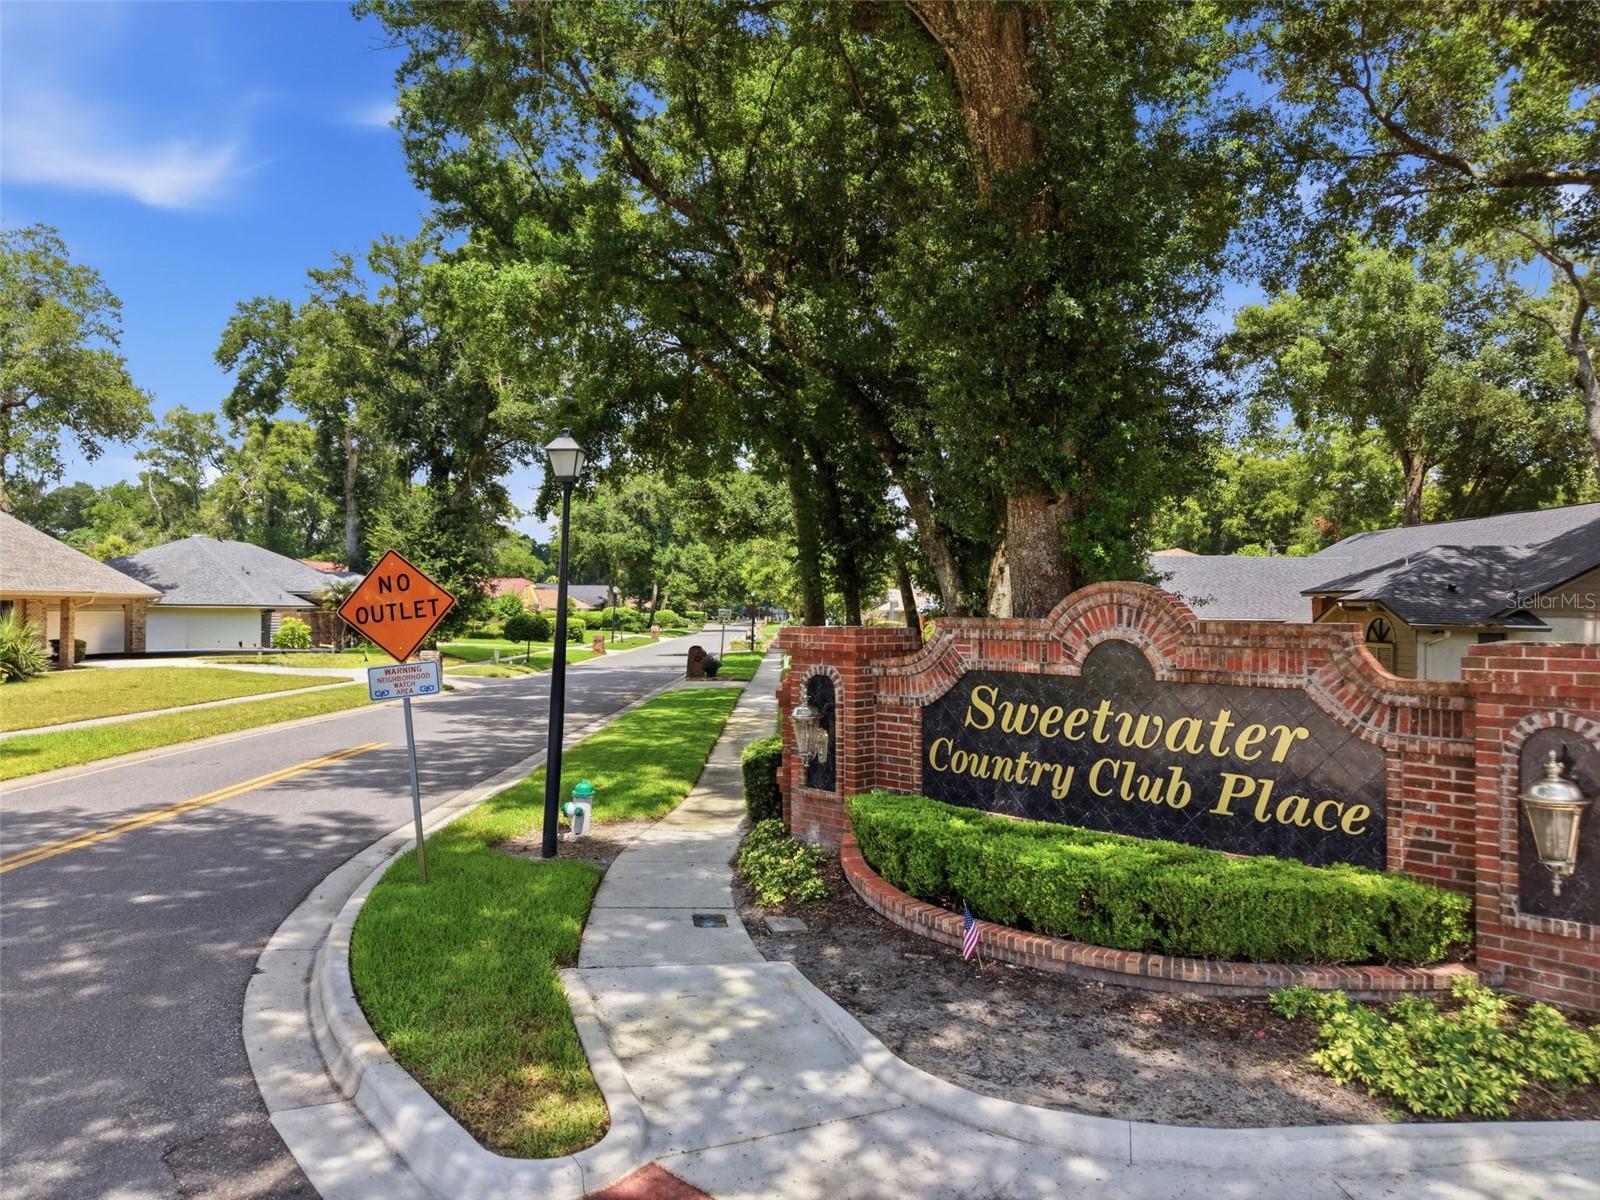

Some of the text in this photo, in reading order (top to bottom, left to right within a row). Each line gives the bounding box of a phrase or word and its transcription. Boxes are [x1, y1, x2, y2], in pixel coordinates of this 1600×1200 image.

[378, 573, 410, 594] NO
[355, 599, 439, 625] OUTLET
[376, 672, 430, 684] NEIGHBORHOOD
[384, 665, 422, 676] WARNING
[396, 687, 414, 695] AREA
[965, 684, 1309, 764] Sweetwater
[928, 736, 1372, 836] Country Club Place
